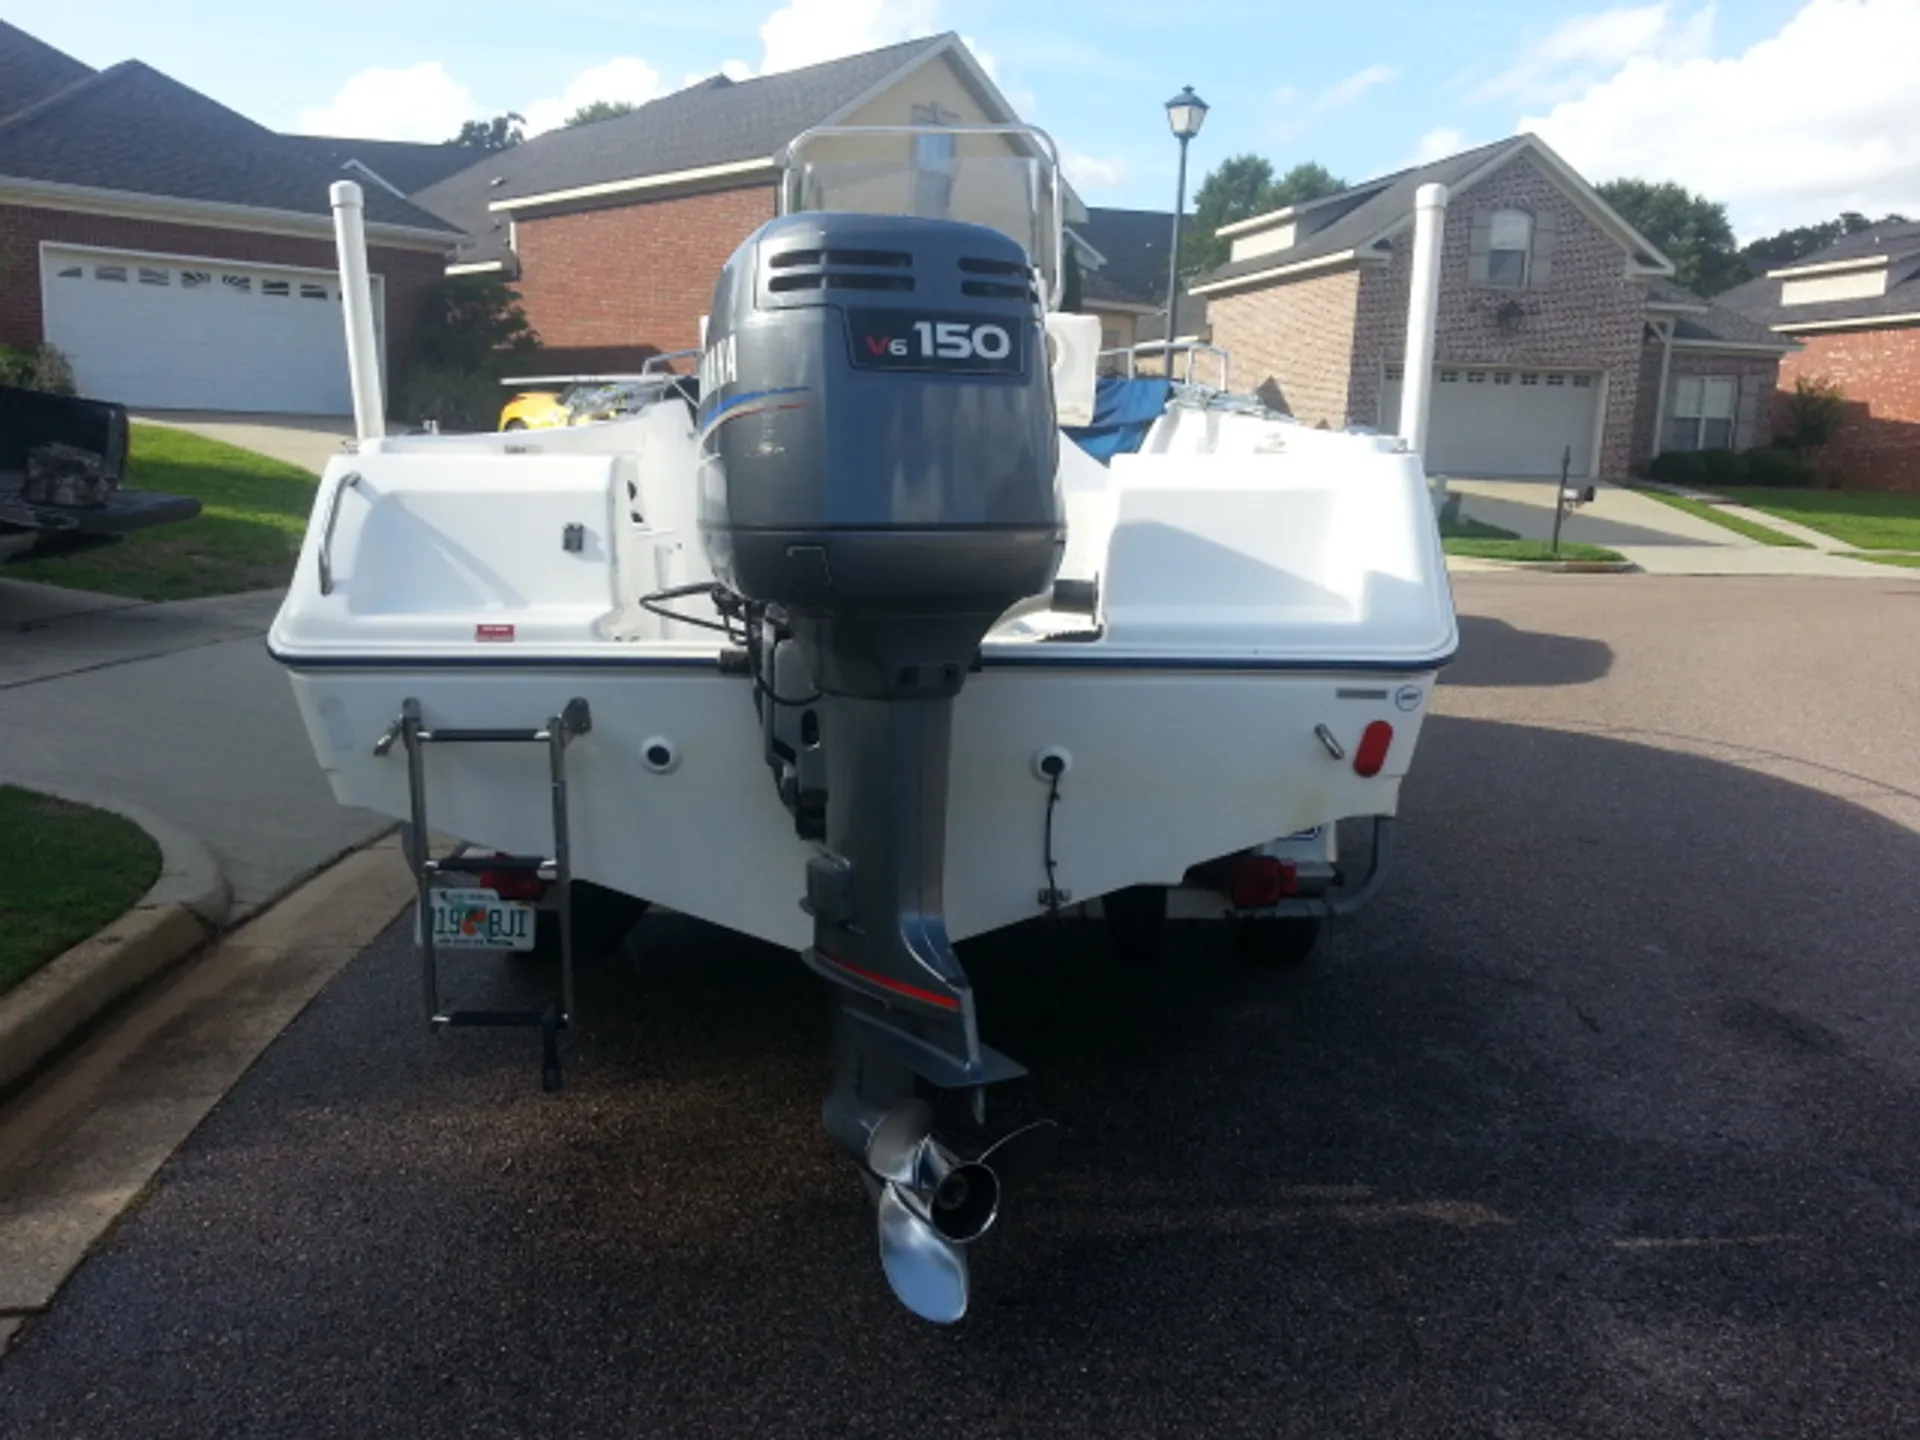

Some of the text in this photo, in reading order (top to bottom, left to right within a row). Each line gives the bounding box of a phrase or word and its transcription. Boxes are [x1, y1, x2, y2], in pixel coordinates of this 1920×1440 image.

[866, 321, 1011, 360] V6 150
[433, 906, 461, 934] 19
